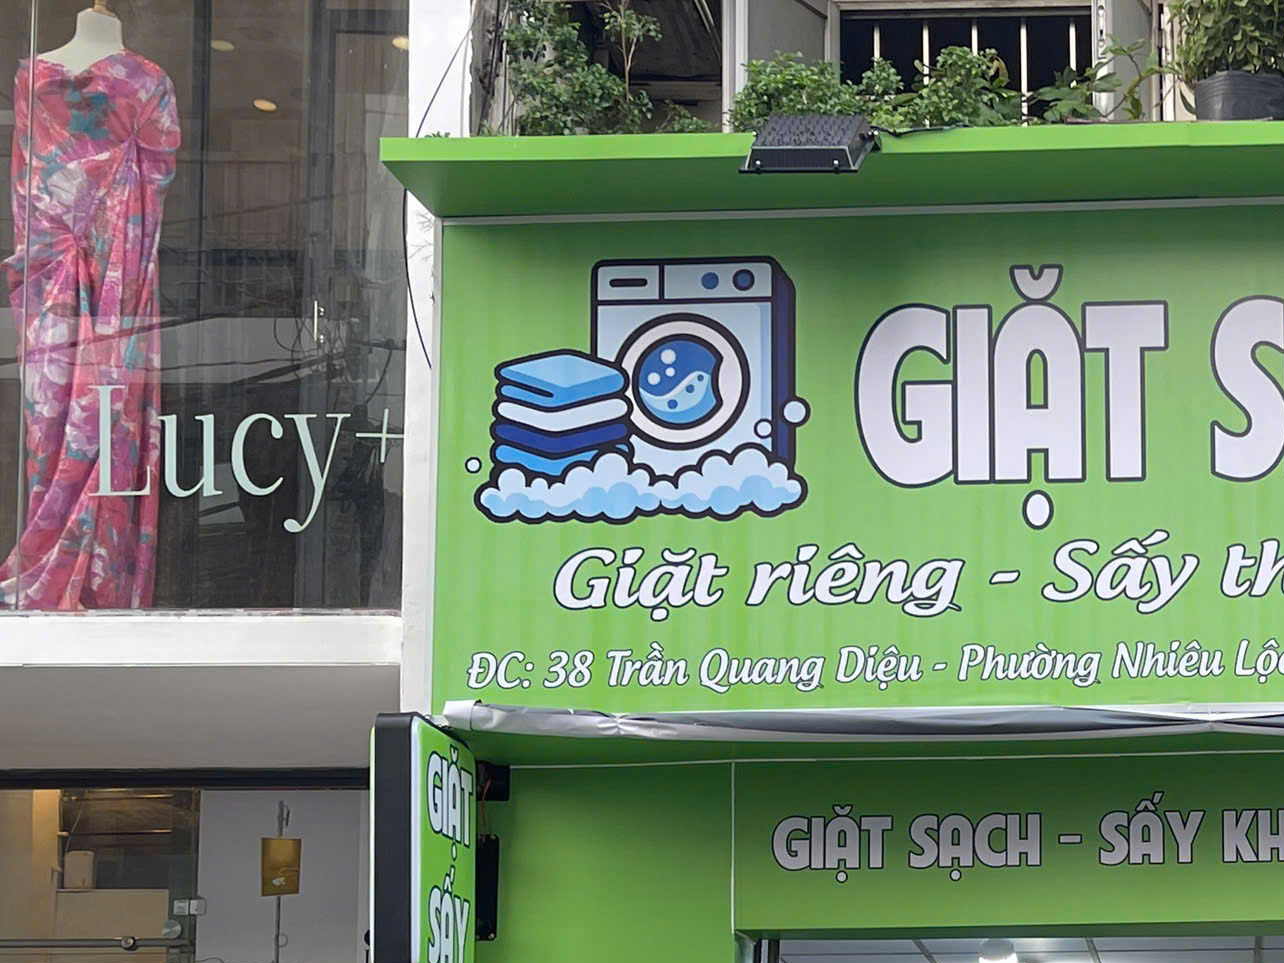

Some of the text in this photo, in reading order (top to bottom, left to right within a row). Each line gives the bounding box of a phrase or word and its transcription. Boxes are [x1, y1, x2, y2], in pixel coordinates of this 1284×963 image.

[854, 264, 1168, 529] GIẶT
[553, 546, 729, 621] Giặt
[746, 543, 964, 617] riêng
[1041, 529, 1199, 614] Sấy
[467, 651, 535, 690] ĐC:
[542, 650, 594, 688] 38
[605, 641, 689, 687] Trần
[700, 648, 825, 694] Quang
[835, 645, 923, 690] Diệu
[958, 642, 1102, 687] Phường
[1111, 639, 1225, 680] Nhiêu
[427, 744, 473, 861] GIẶT
[772, 804, 893, 883] GIẶT
[907, 812, 1042, 882] SẠCH
[1099, 791, 1206, 867] SẤY
